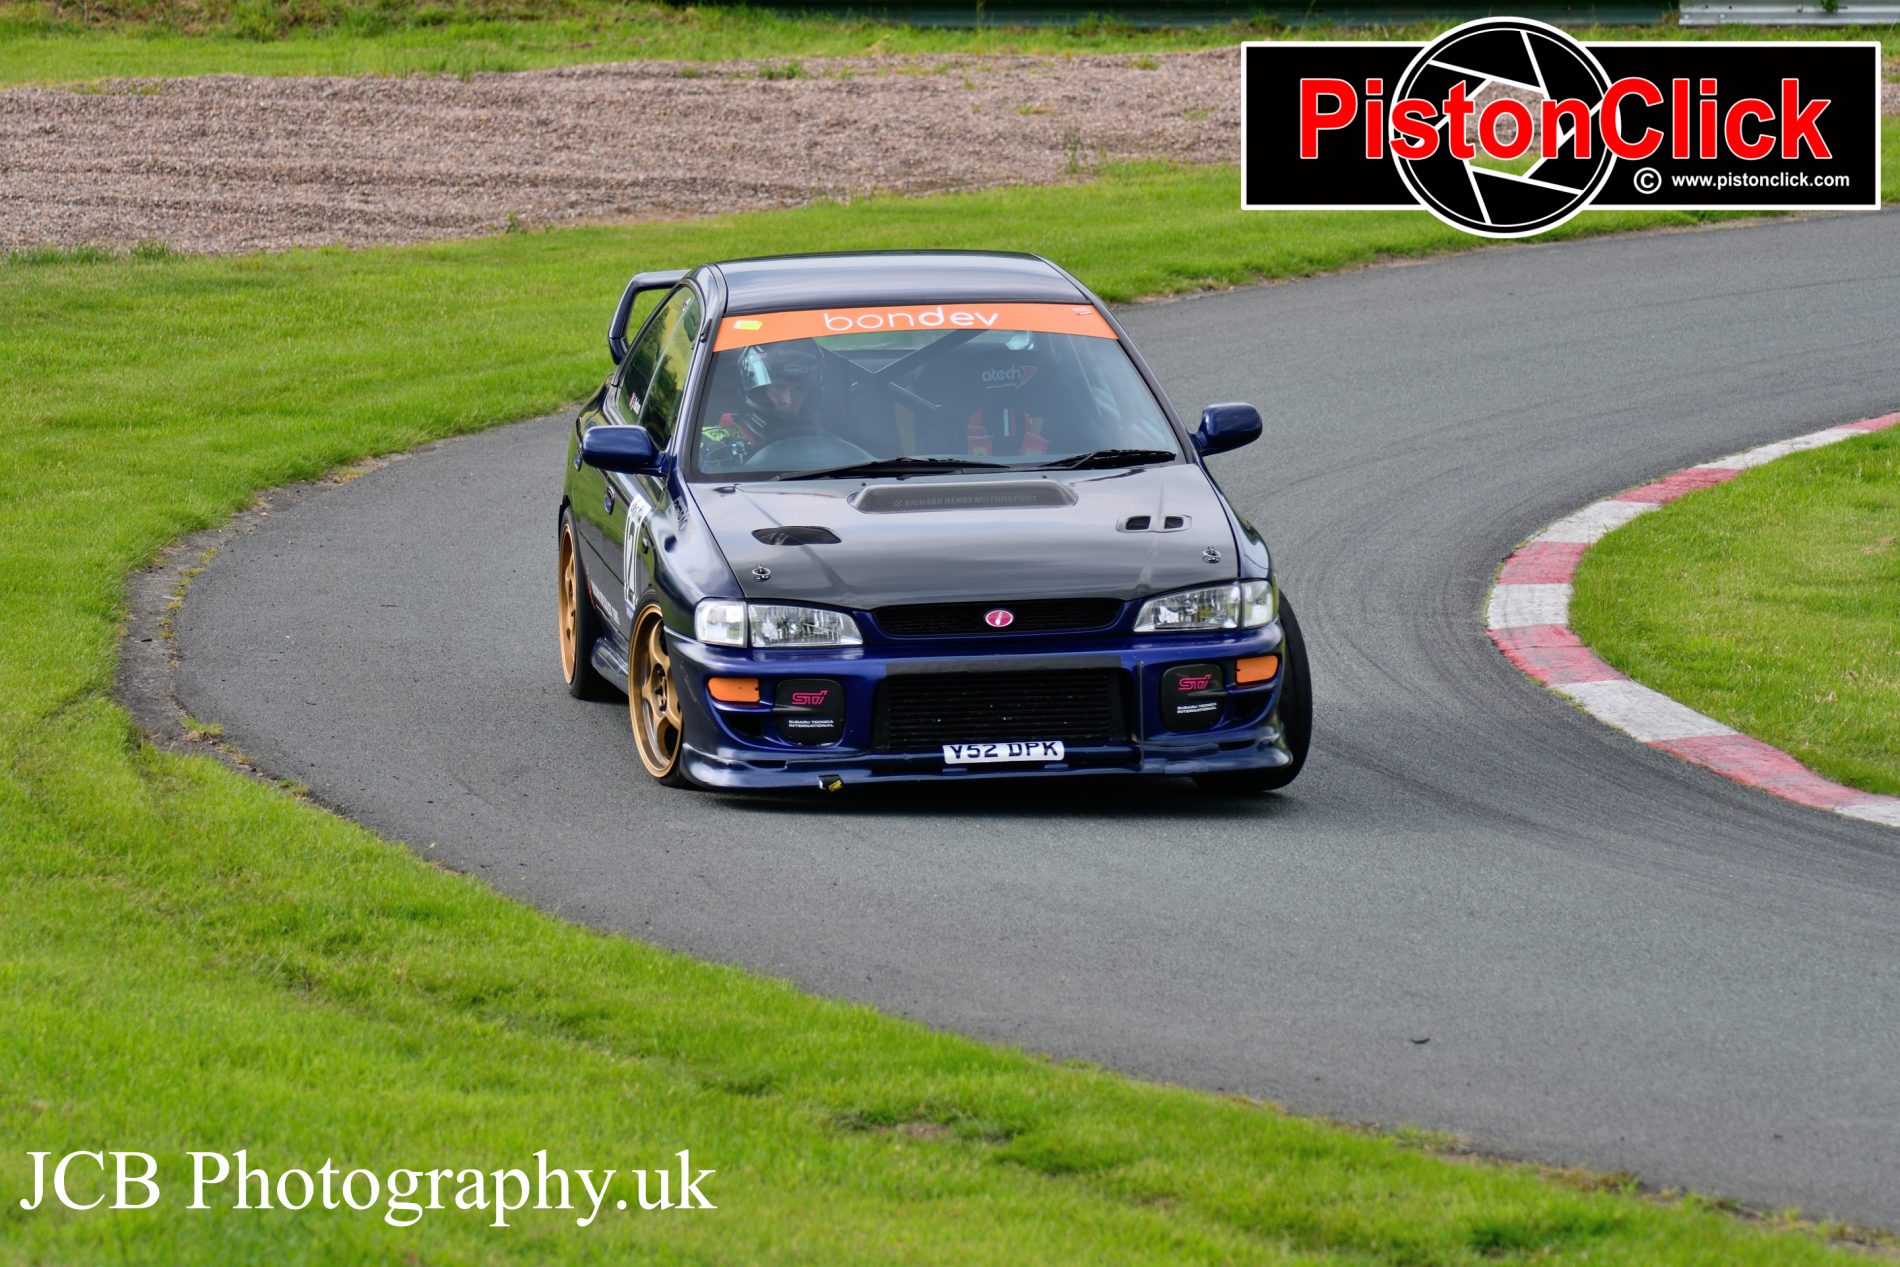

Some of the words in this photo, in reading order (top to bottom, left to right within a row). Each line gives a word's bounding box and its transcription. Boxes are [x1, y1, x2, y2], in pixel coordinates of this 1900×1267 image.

[823, 306, 999, 332] bondev
[904, 497, 943, 507] RICHARD
[949, 744, 999, 760] Y52
[1007, 741, 1058, 757] DPK
